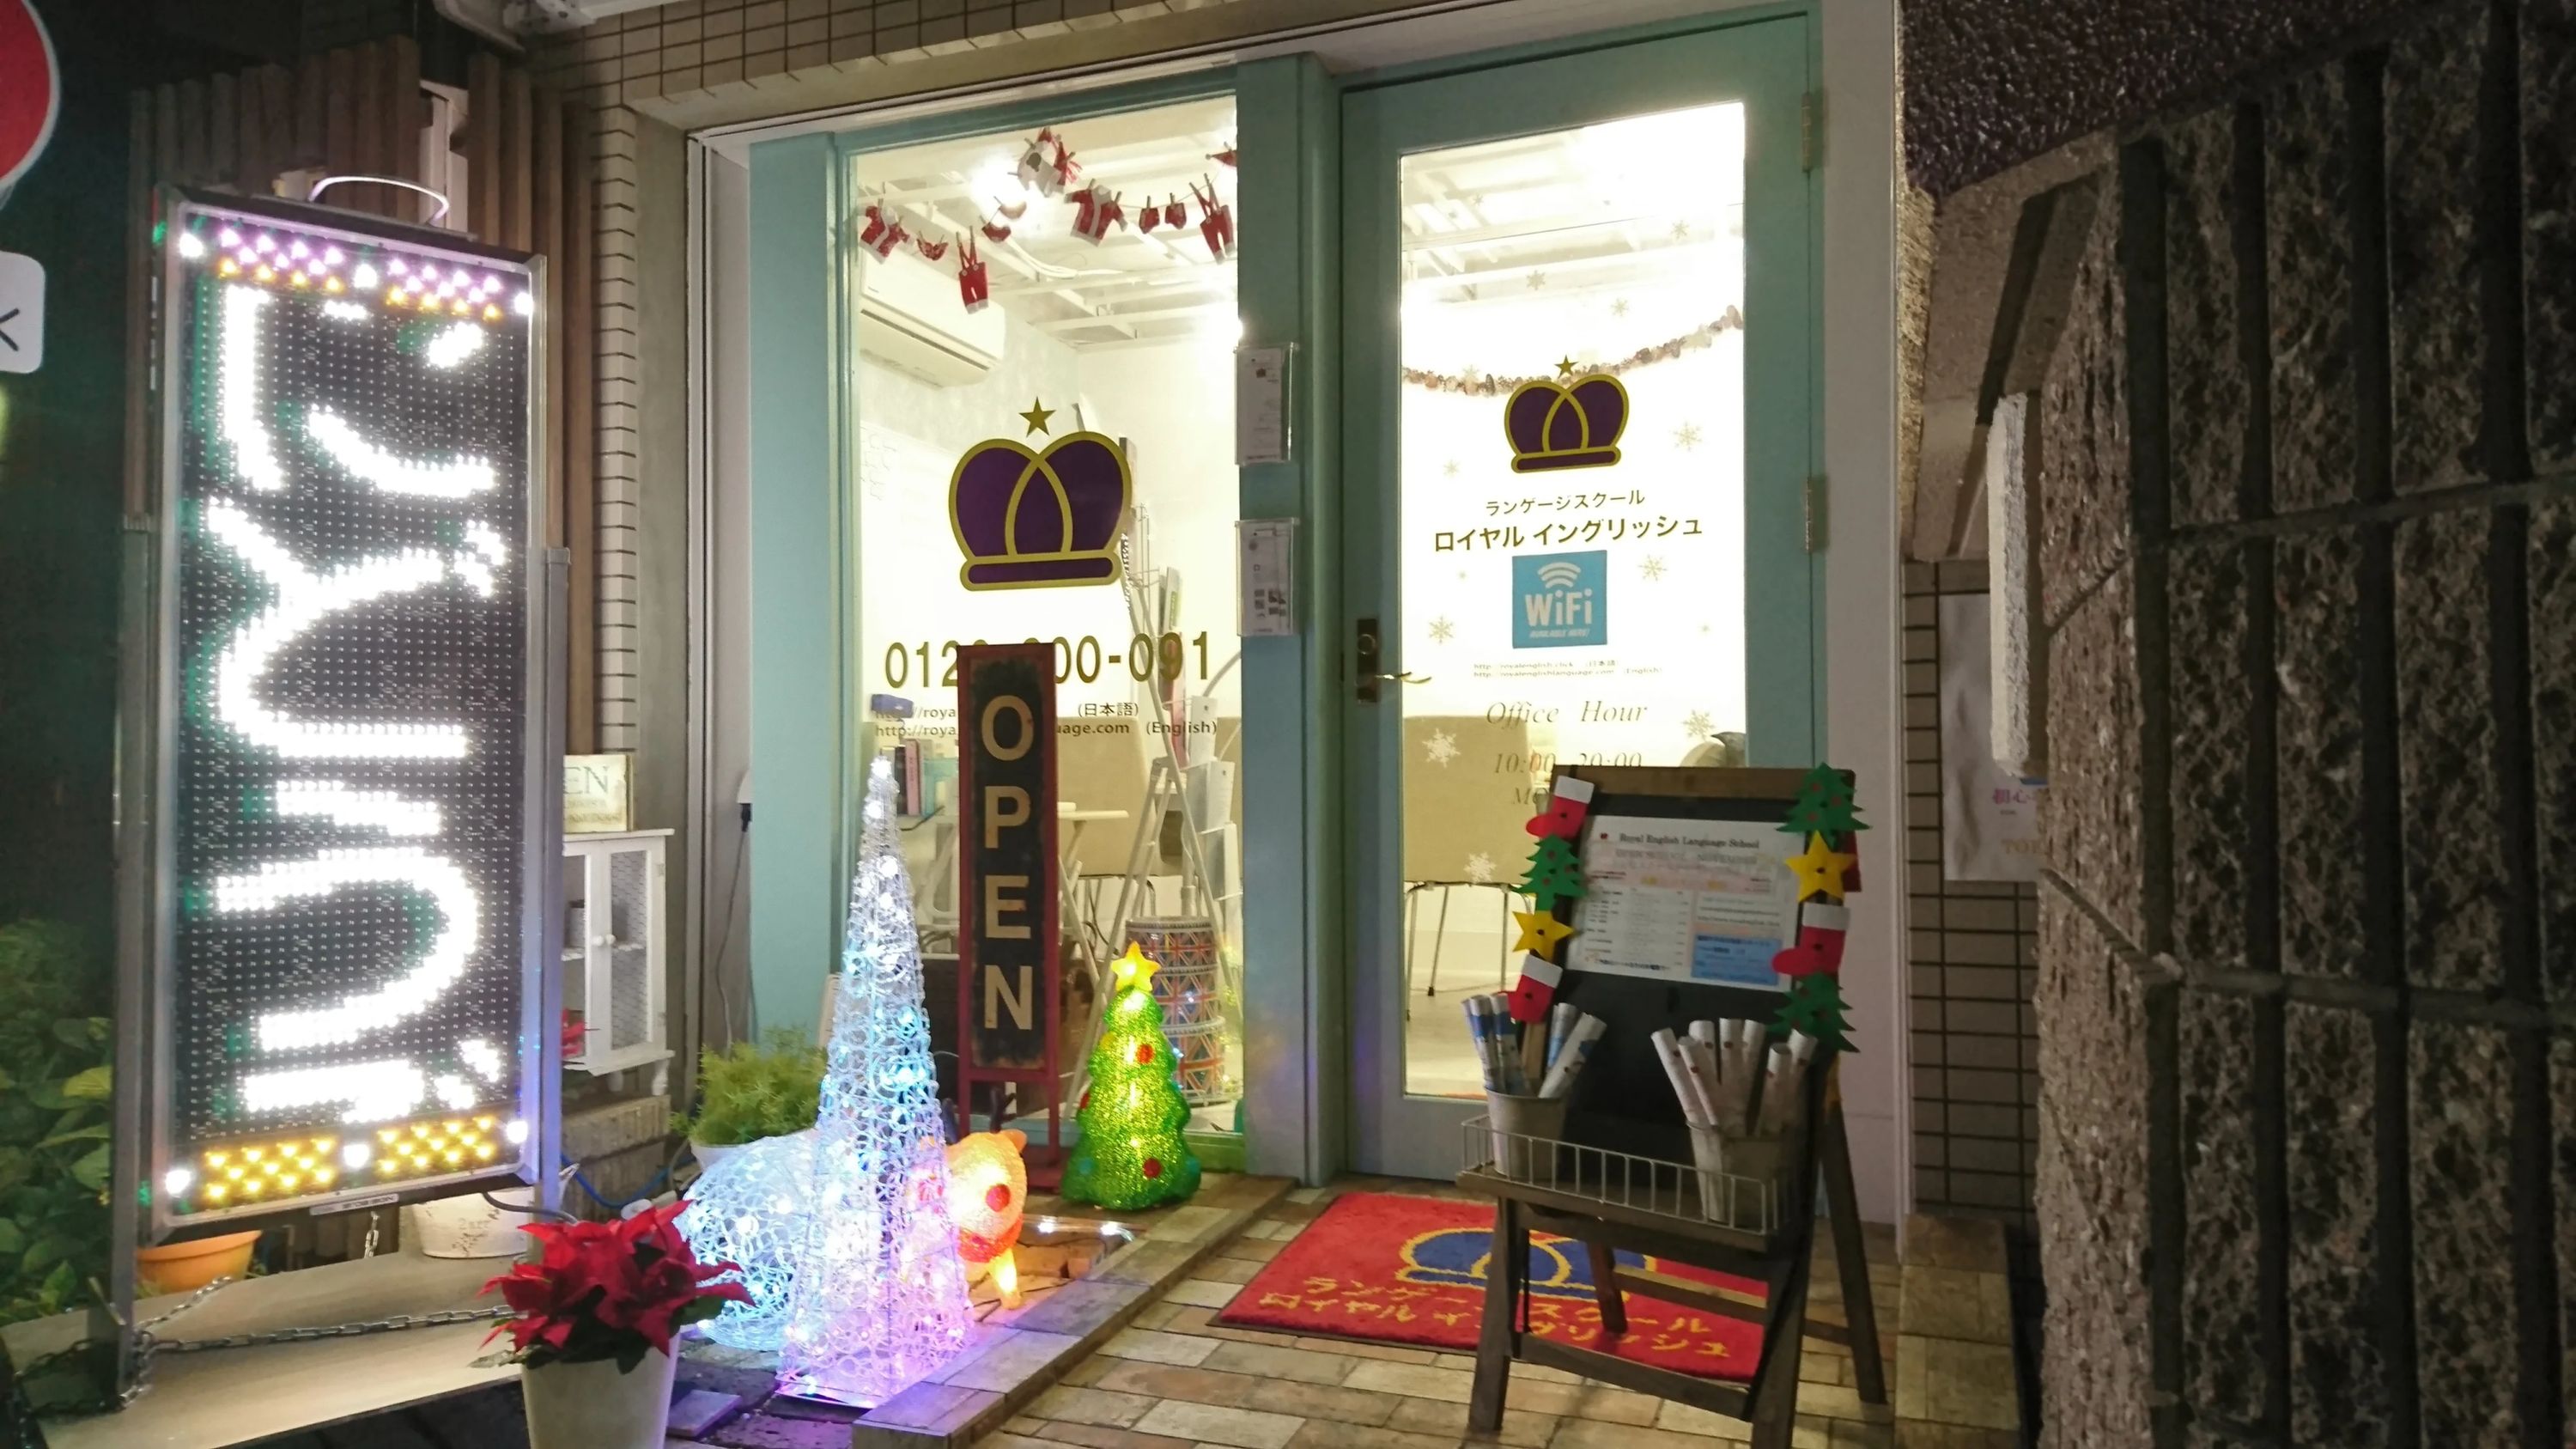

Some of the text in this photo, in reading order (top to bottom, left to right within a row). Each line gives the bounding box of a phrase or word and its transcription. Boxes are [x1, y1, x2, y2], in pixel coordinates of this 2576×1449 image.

[1486, 490, 1645, 516] ランゲージスクール
[1435, 515, 1703, 552] ロイヤル イングリッシュ
[1525, 588, 1593, 627] WiFi
[1078, 703, 1139, 716] (日本語)
[1486, 700, 1647, 729] Office Hour
[1145, 721, 1218, 735] (English)
[981, 695, 1035, 1031] OPEN
